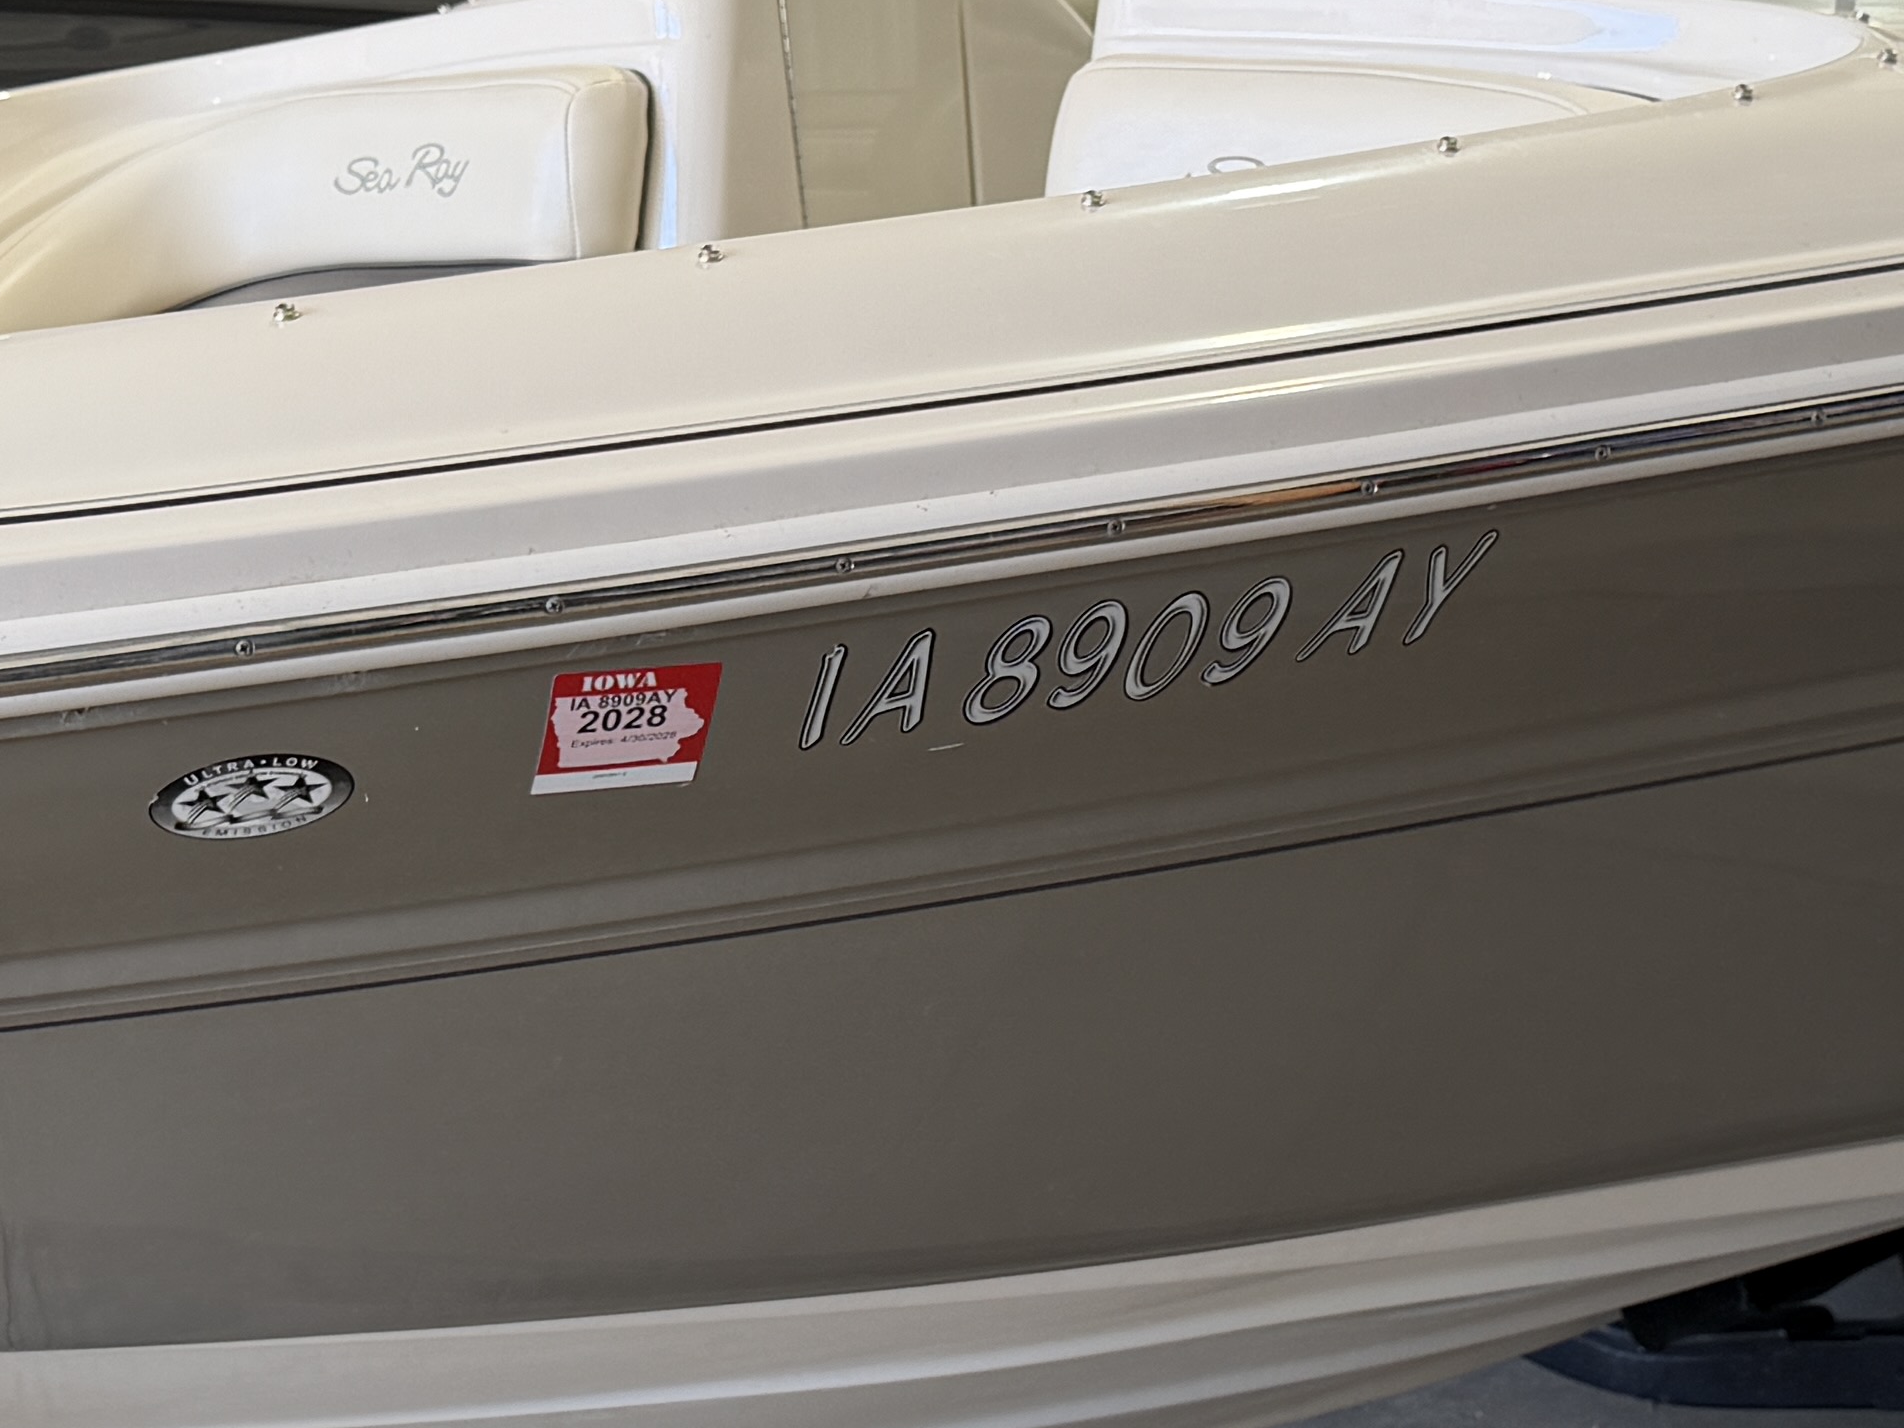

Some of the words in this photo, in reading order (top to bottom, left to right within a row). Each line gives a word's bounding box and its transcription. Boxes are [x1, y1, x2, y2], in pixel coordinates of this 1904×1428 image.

[333, 156, 401, 196] Sea
[403, 142, 471, 199] Ray
[798, 627, 936, 751] IA
[961, 575, 1293, 726] 8909
[1296, 529, 1500, 662] AY
[581, 671, 658, 693] IOWA
[569, 697, 592, 712] IA
[597, 690, 679, 710] 8909AY
[576, 704, 669, 735] 2028
[183, 758, 255, 786] ULTRA
[271, 756, 319, 770] LOW
